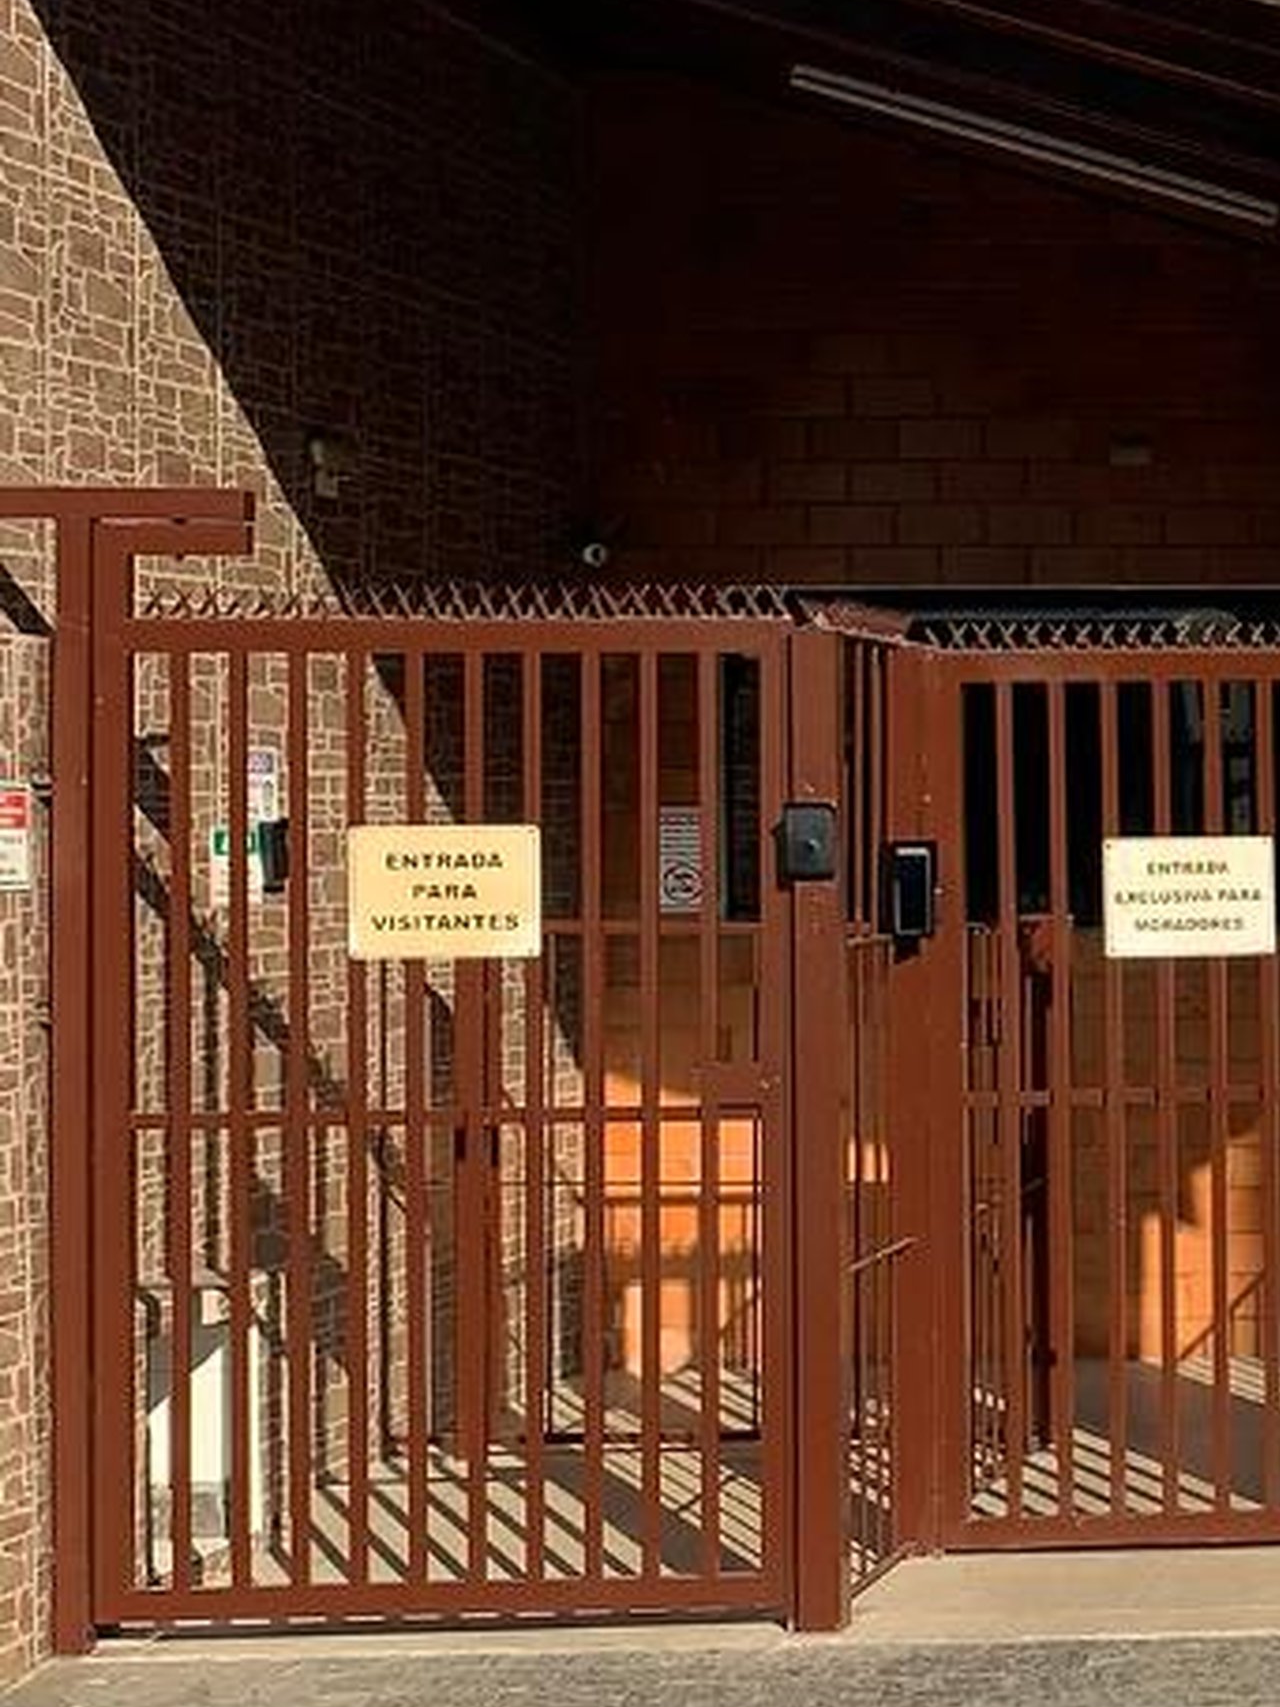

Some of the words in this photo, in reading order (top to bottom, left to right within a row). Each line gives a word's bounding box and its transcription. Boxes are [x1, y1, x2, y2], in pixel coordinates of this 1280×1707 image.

[385, 852, 503, 870] ENTRADA
[1146, 860, 1229, 876] ENTRADA
[412, 883, 478, 900] PARA
[1114, 887, 1213, 906] EXCLUSIVA
[1217, 887, 1262, 902] PARA
[371, 913, 520, 932] VISITANTES
[1134, 917, 1244, 933] MORADORES
